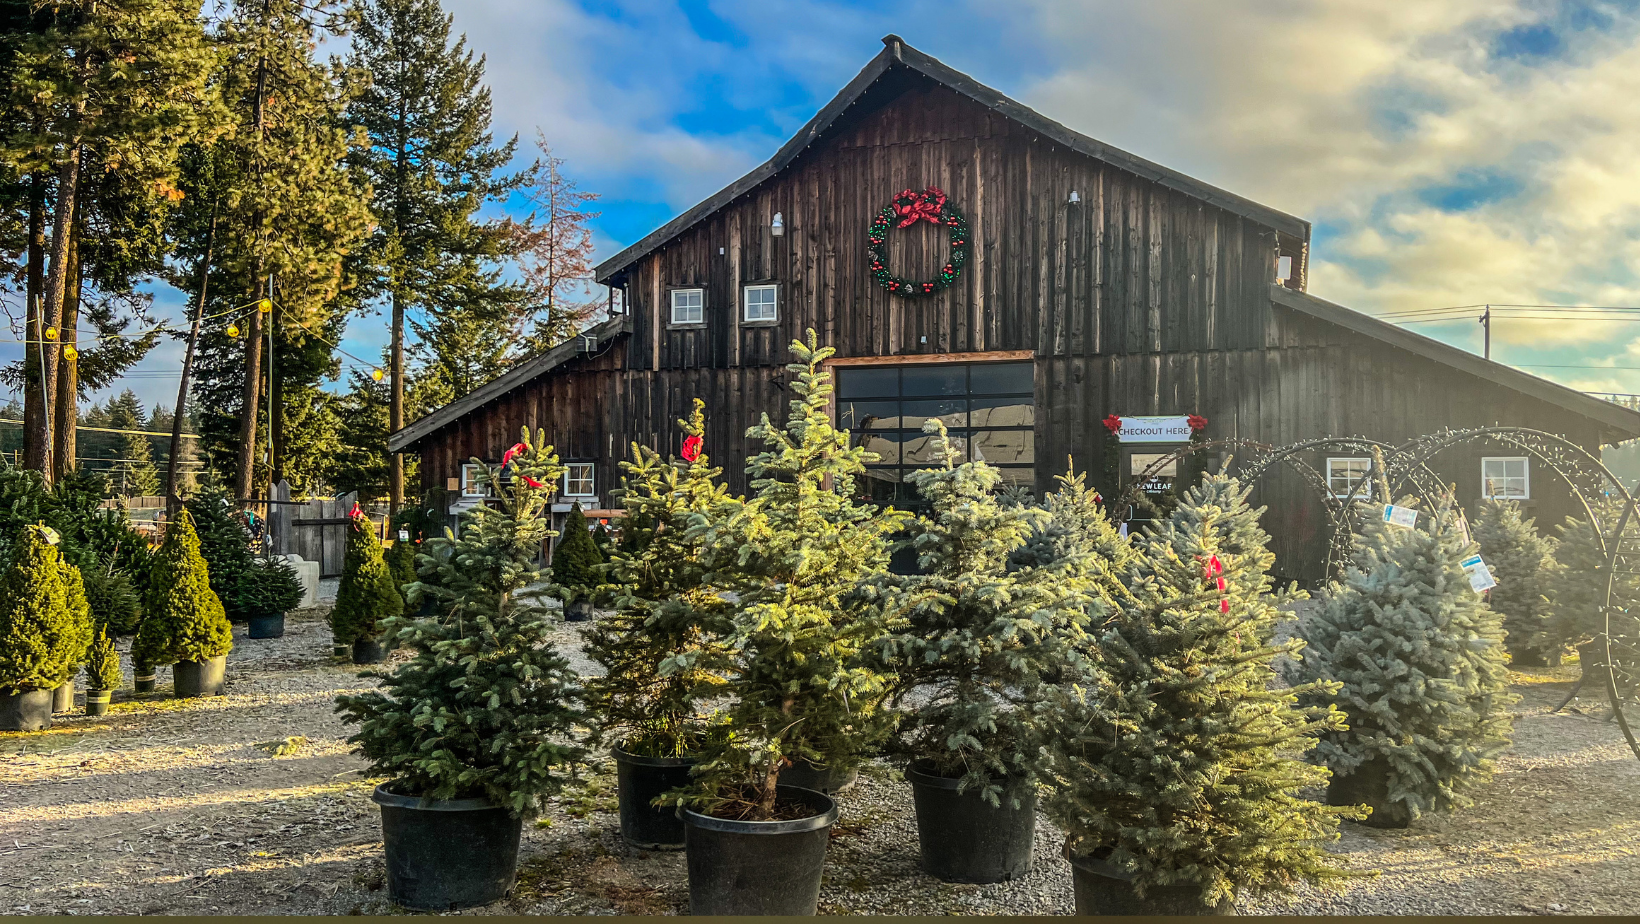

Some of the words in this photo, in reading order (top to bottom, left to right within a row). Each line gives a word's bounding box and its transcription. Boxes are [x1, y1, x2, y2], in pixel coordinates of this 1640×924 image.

[1118, 427, 1163, 436] CHECKOUT
[1165, 427, 1189, 435] HERE
[1153, 482, 1172, 490] LEAF
